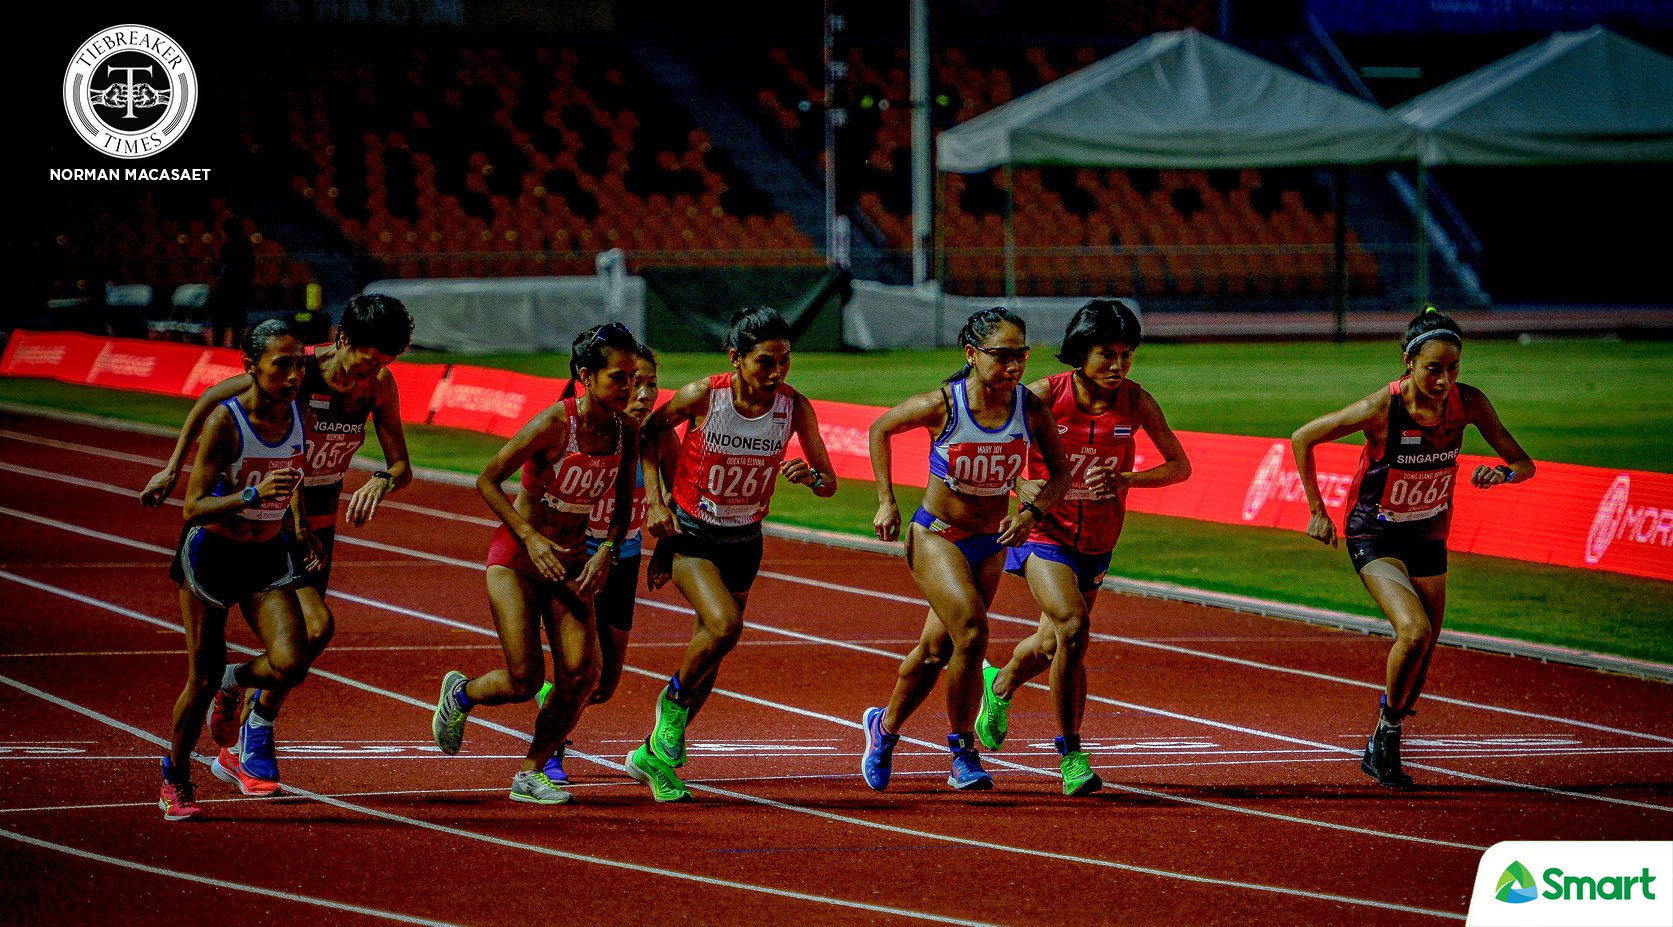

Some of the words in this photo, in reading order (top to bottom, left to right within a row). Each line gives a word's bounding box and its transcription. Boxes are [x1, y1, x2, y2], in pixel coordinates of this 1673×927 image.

[706, 431, 782, 451] INDONESIA
[977, 445, 992, 454] MARY
[992, 445, 1003, 454] JOY
[1396, 447, 1459, 464] SINGAPORE
[559, 465, 619, 497] 0967
[707, 464, 773, 497] 0261
[954, 453, 1022, 483] 0052
[1390, 474, 1453, 506] 0662
